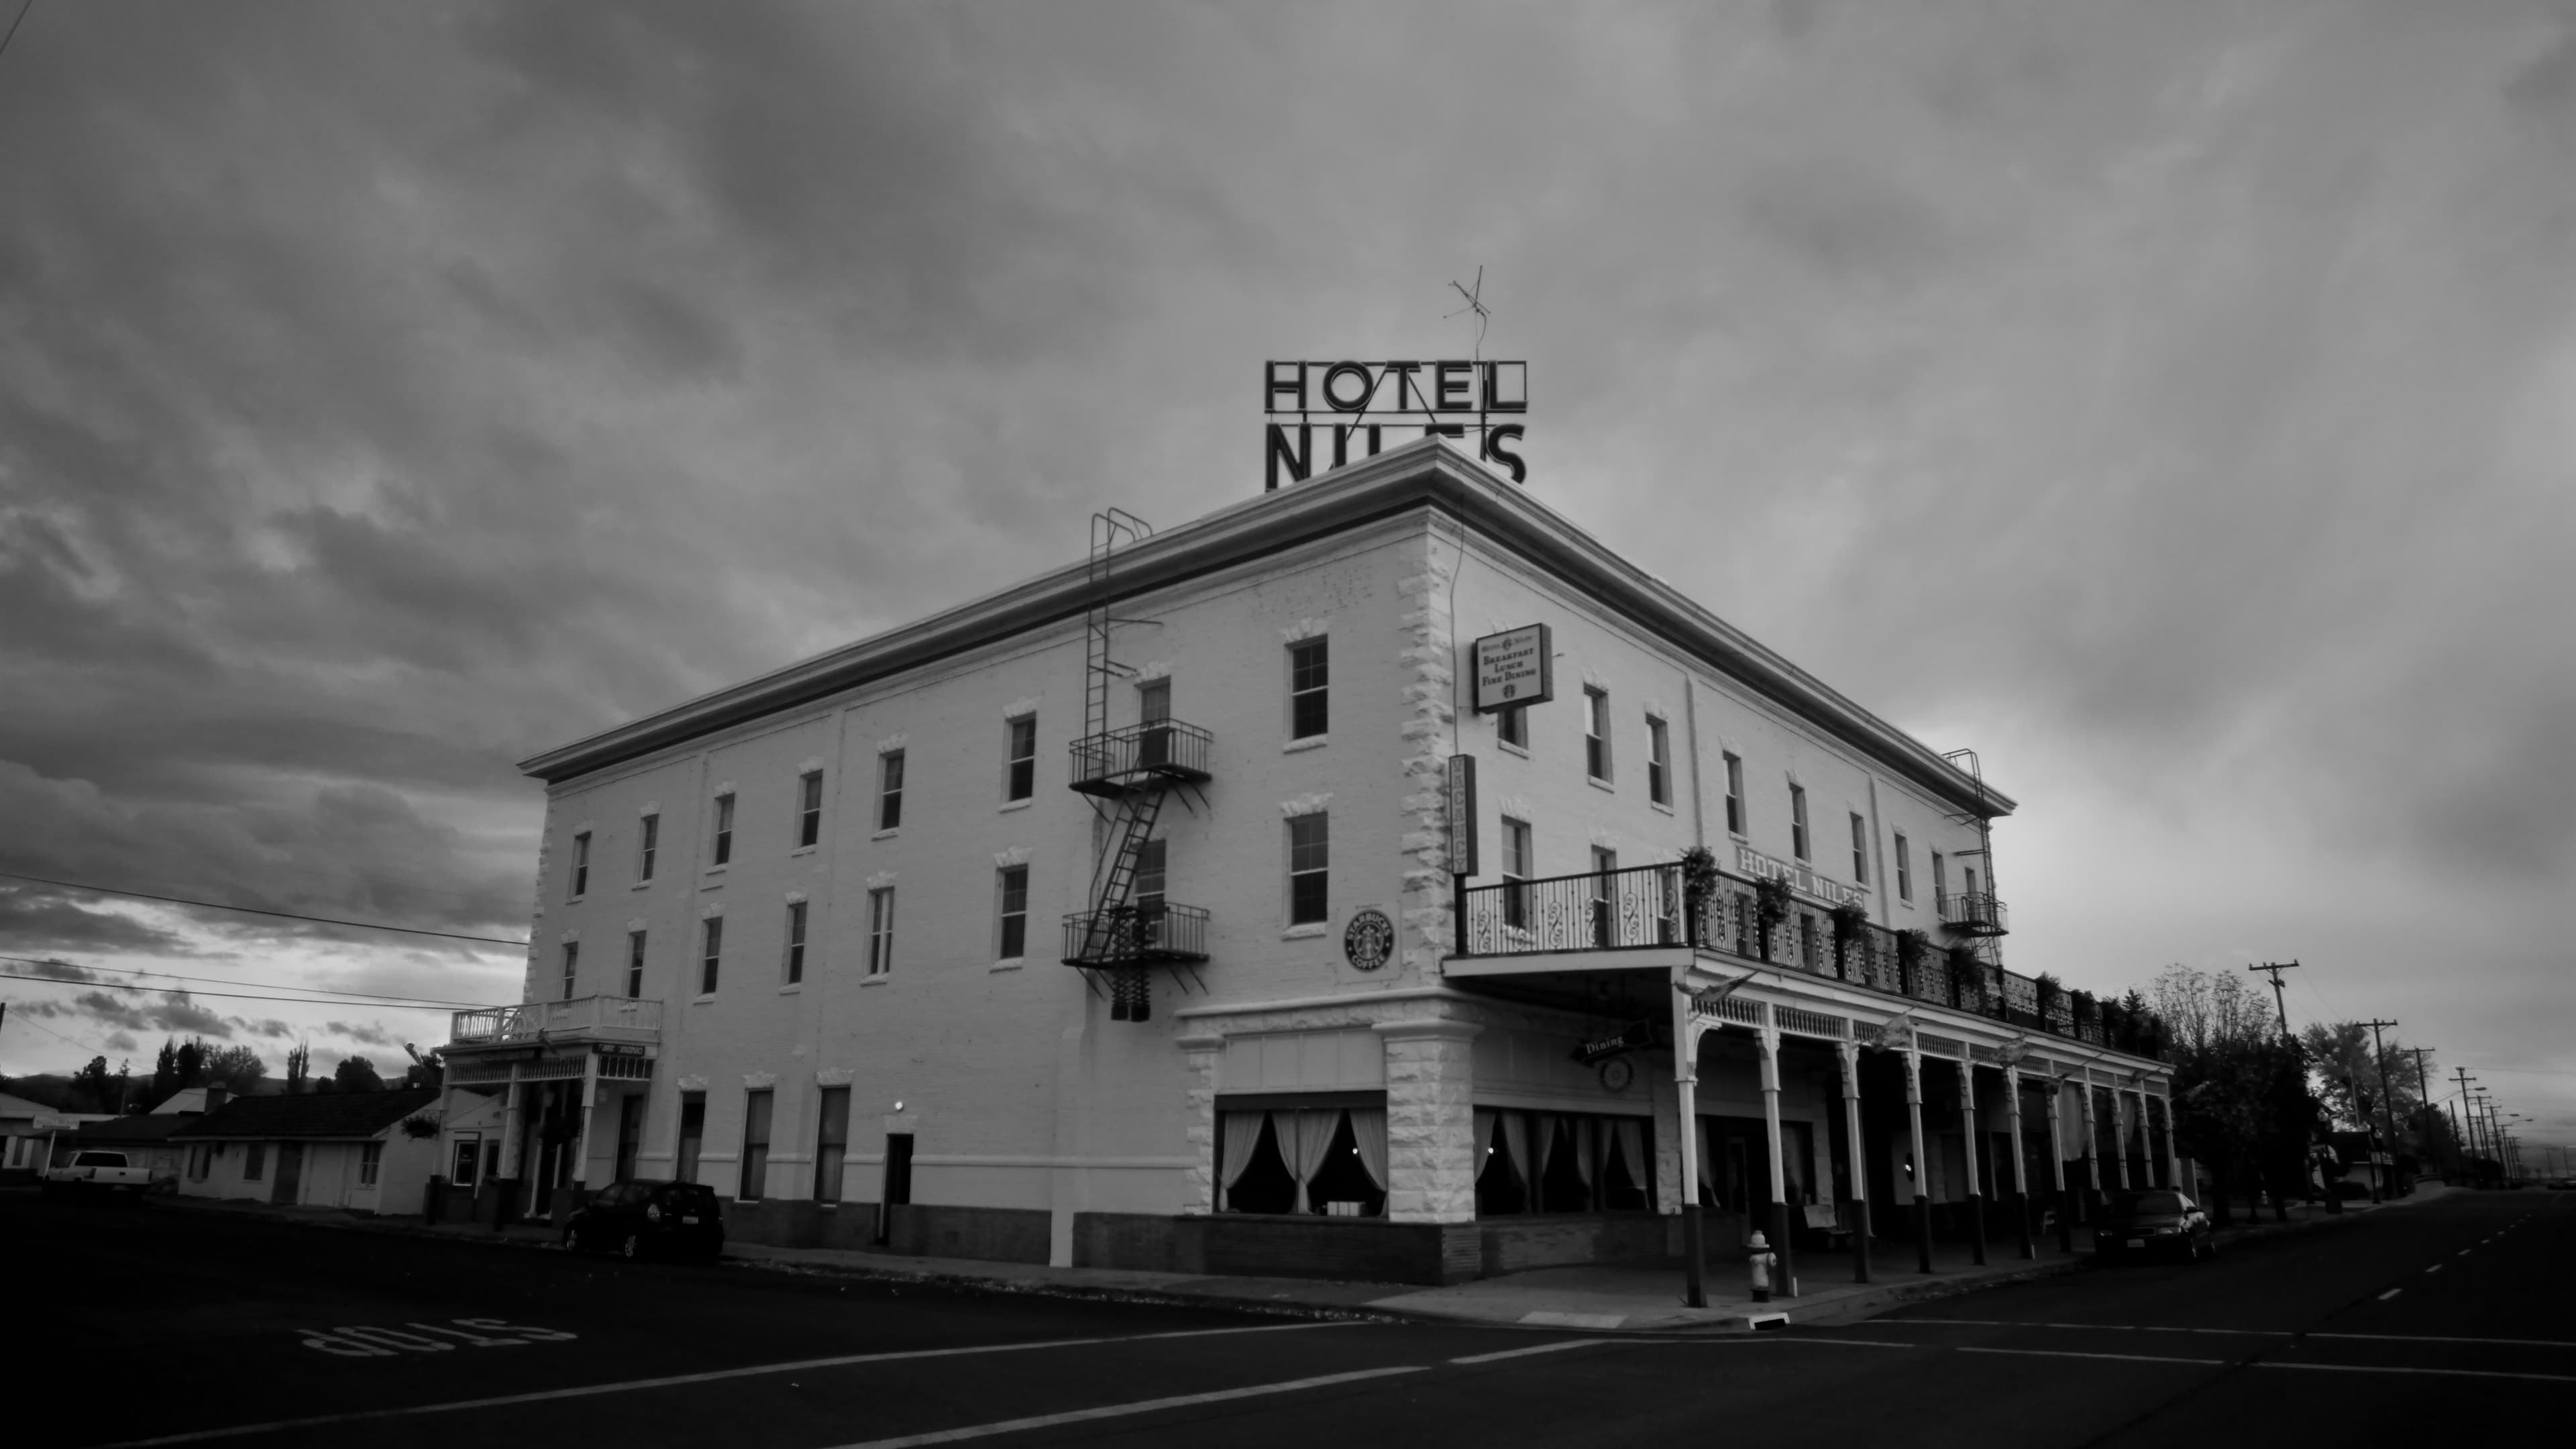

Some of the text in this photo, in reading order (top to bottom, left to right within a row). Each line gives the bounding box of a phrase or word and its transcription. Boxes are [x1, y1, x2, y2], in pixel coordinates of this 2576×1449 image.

[1265, 360, 1528, 412] HOTEL
[1265, 423, 1527, 492] NIS
[1483, 647, 1534, 665] BREAKFAST
[1495, 660, 1523, 674] LUNCH
[1740, 849, 1807, 891] HOTEL
[1586, 1036, 1624, 1054] Dining
